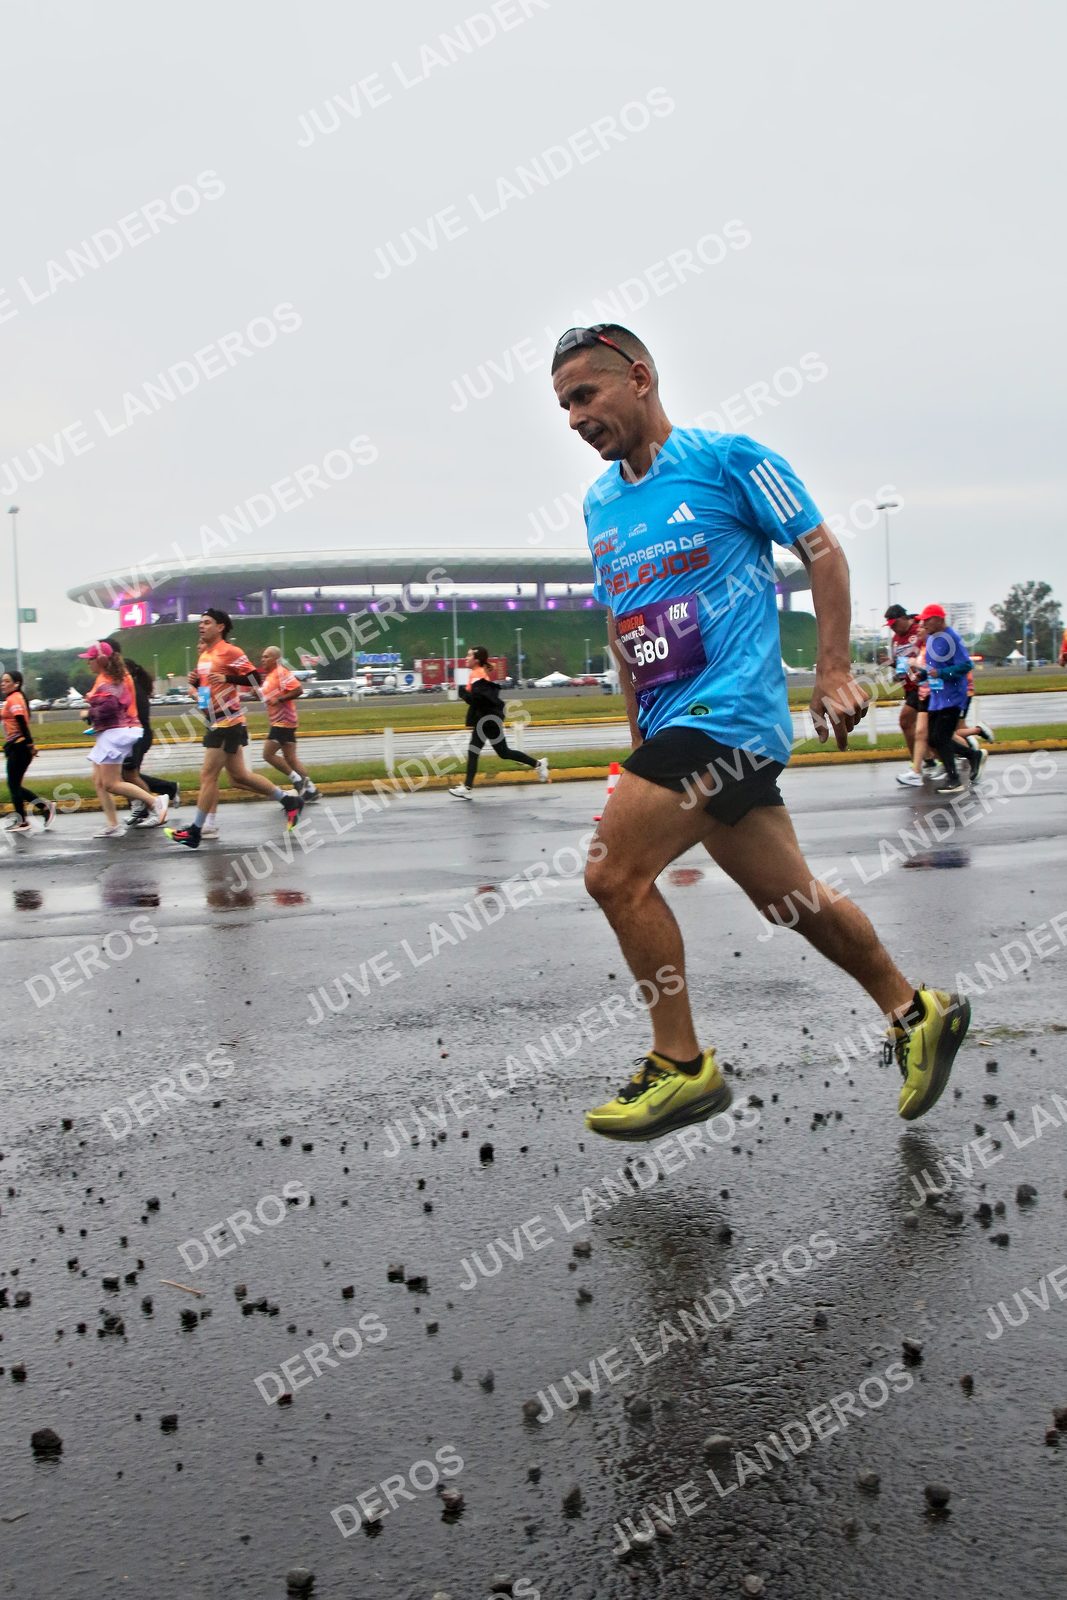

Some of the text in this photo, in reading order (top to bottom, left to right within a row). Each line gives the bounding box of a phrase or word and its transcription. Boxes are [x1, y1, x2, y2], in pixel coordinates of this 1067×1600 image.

[611, 540, 676, 571] CARRERA
[679, 533, 706, 550] DE
[604, 546, 711, 597] RELEVOS
[668, 602, 689, 621] 15K
[633, 636, 669, 667] 580
